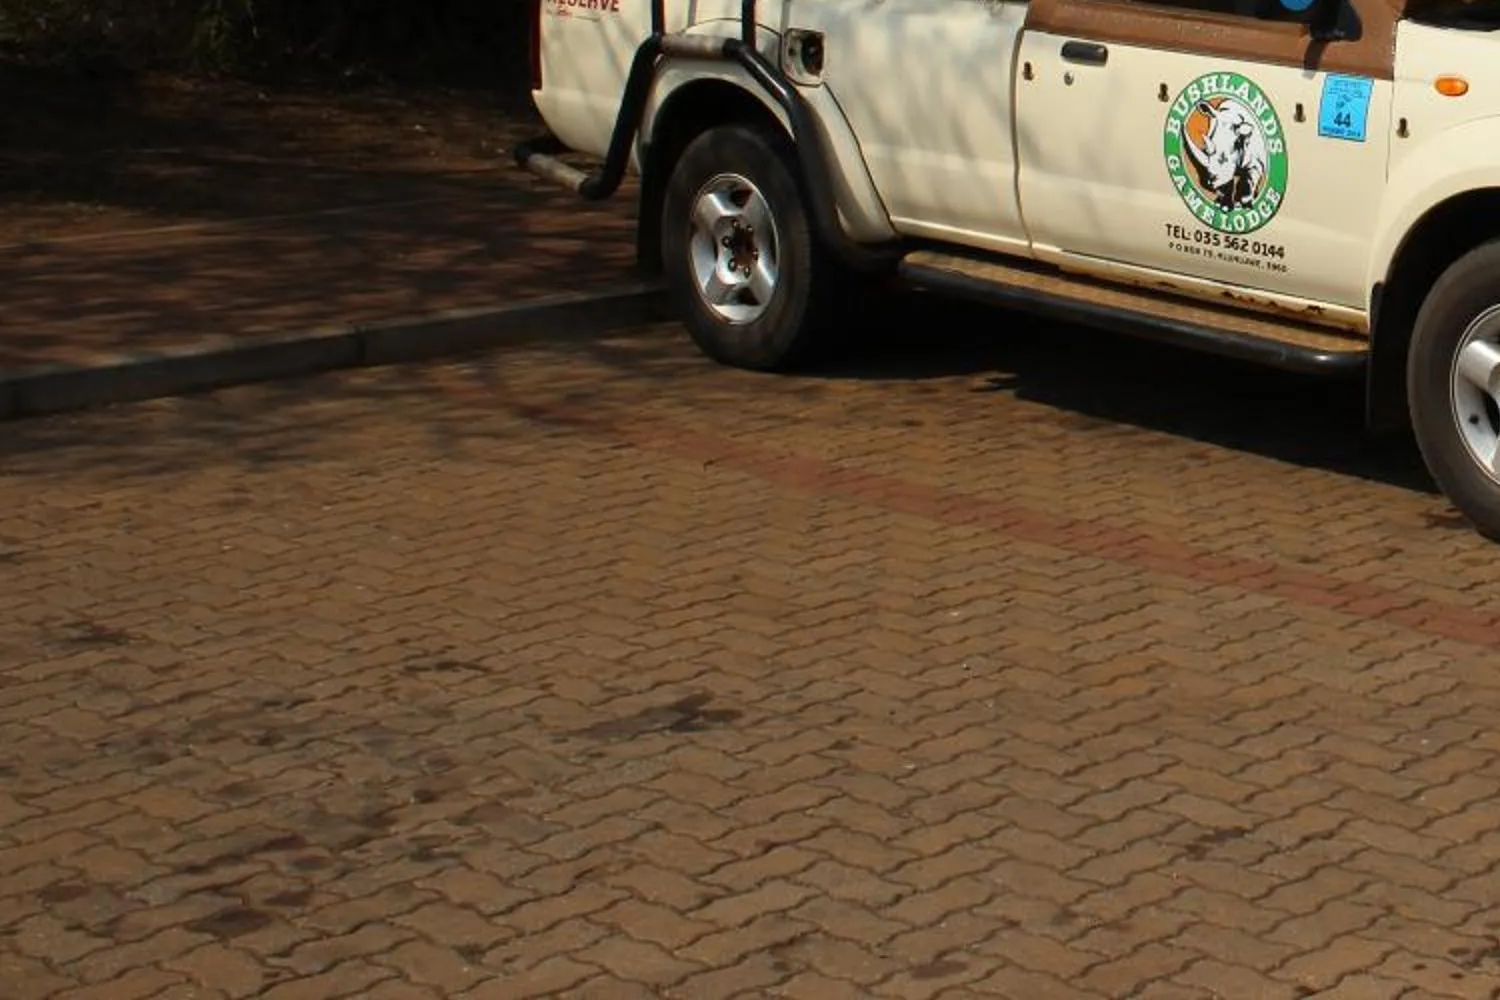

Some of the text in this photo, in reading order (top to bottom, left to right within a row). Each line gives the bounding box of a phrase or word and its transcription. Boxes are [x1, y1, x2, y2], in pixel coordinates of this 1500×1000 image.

[1166, 75, 1283, 153] BUSHLANDS
[1333, 111, 1351, 128] 44
[1167, 155, 1281, 232] GAME LODGE
[1165, 223, 1285, 259] TEL: 035 562 0144
